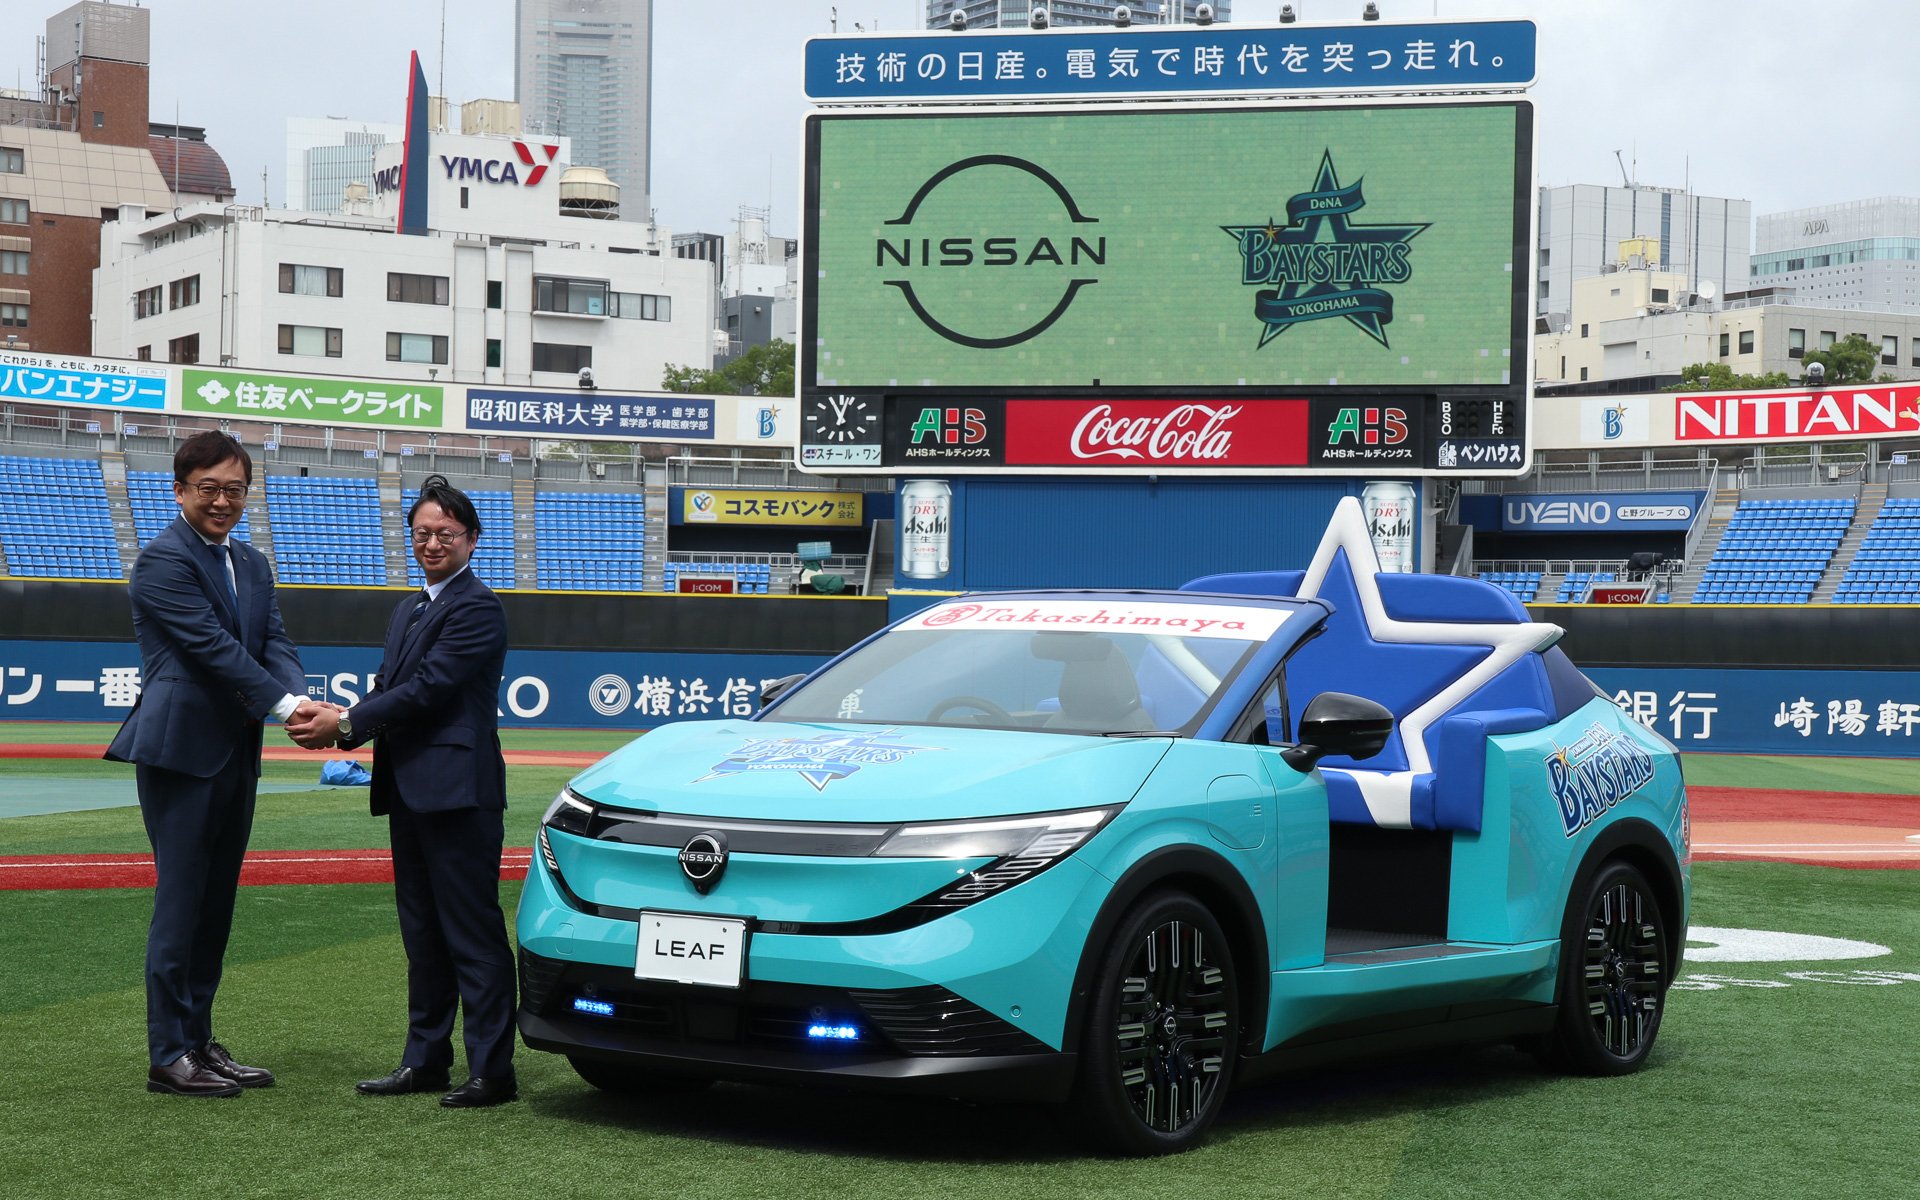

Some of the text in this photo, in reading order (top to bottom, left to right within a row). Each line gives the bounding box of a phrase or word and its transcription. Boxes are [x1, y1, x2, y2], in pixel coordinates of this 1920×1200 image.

[836, 39, 1506, 83] 技術の日産。電気で時代を突っ走れ。
[441, 155, 519, 185] YMCA
[1310, 196, 1343, 211] DeNA
[1802, 219, 1829, 236] APA
[877, 236, 1106, 267] NISSAN
[1240, 226, 1412, 285] BAYSTARS
[1287, 295, 1360, 317] YOKOHAMA
[0, 369, 163, 403] バンエナジー
[234, 381, 433, 419] 住友ベークライト
[1442, 401, 1503, 413] B H
[470, 399, 614, 427] 昭和医科大学
[1442, 412, 1502, 424] S E
[1679, 391, 1896, 437] NITTAN
[619, 418, 709, 431] 薬学部・保健医療学部
[1070, 404, 1244, 460] Coca-Cola
[1441, 423, 1452, 435] O
[905, 448, 991, 458] AHSホールディングス
[1322, 449, 1413, 459] AHSホールディングス
[725, 499, 835, 519] コスモバンク
[1507, 501, 1611, 524] UYENO
[1620, 508, 1674, 518] 上野グループ
[905, 516, 946, 534] Asahi
[692, 584, 722, 593] J:COM
[976, 608, 1246, 632] Takashimaya
[1545, 730, 1656, 839] BAYSTARS
[679, 852, 723, 863] NISSAN
[655, 940, 724, 960] LEAF
